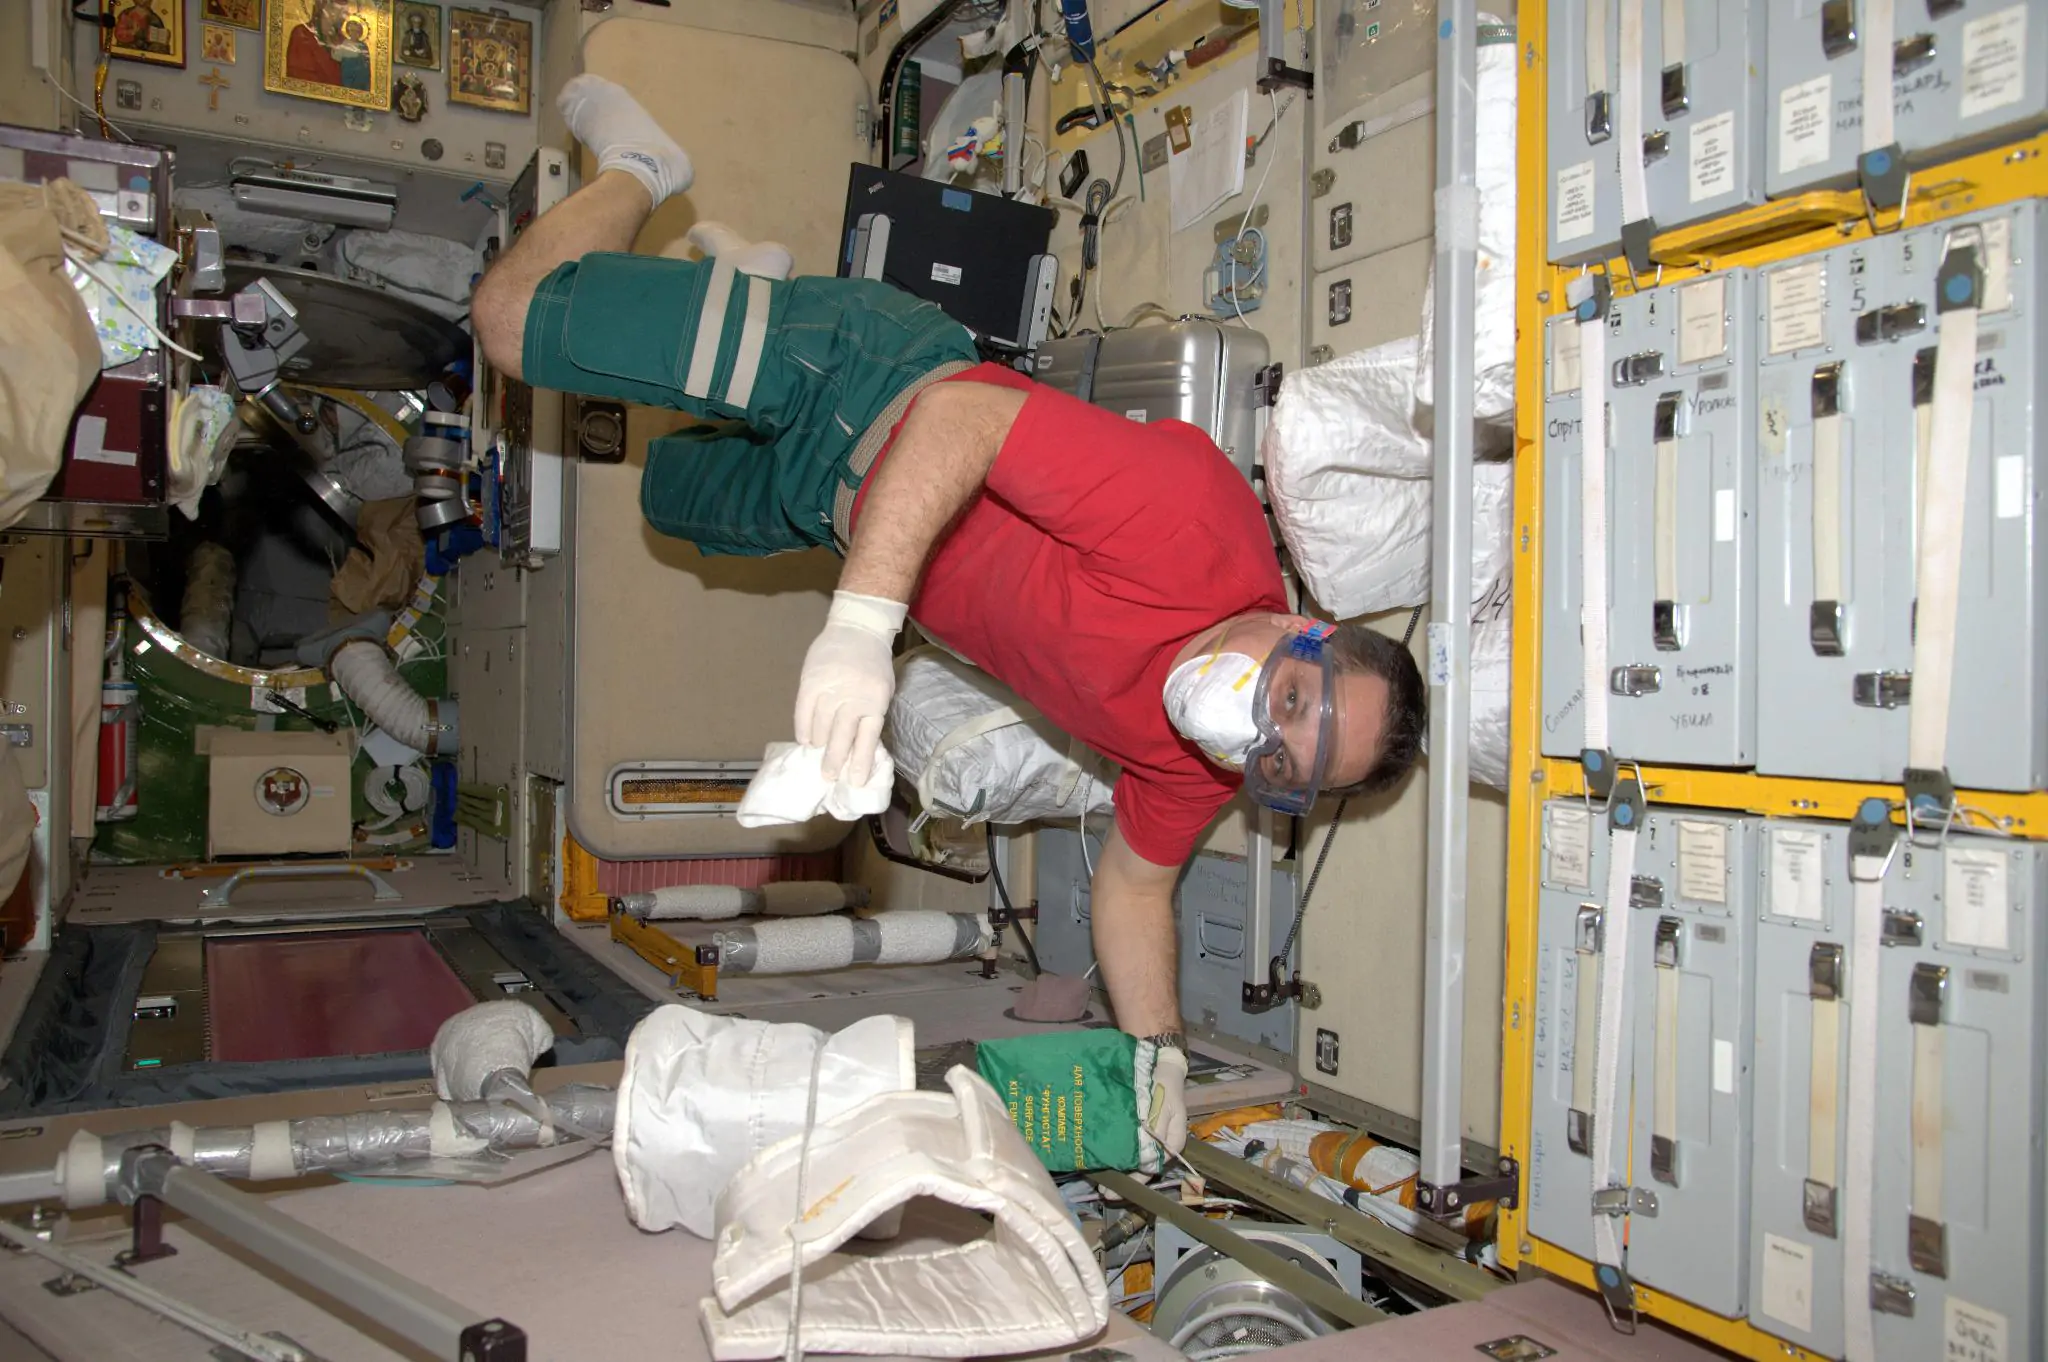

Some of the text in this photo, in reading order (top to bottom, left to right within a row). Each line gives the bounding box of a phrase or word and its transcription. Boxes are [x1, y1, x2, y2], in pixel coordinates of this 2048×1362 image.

[1903, 245, 1912, 261] 5
[1850, 286, 1866, 312] 5
[1650, 828, 1656, 841] 7
[1073, 1065, 1083, 1086] ДЛЯ
[1008, 1080, 1019, 1097] KIT
[1024, 1095, 1034, 1143] SURFACE
[1057, 1095, 1066, 1142] КОМПЛЕКТ
